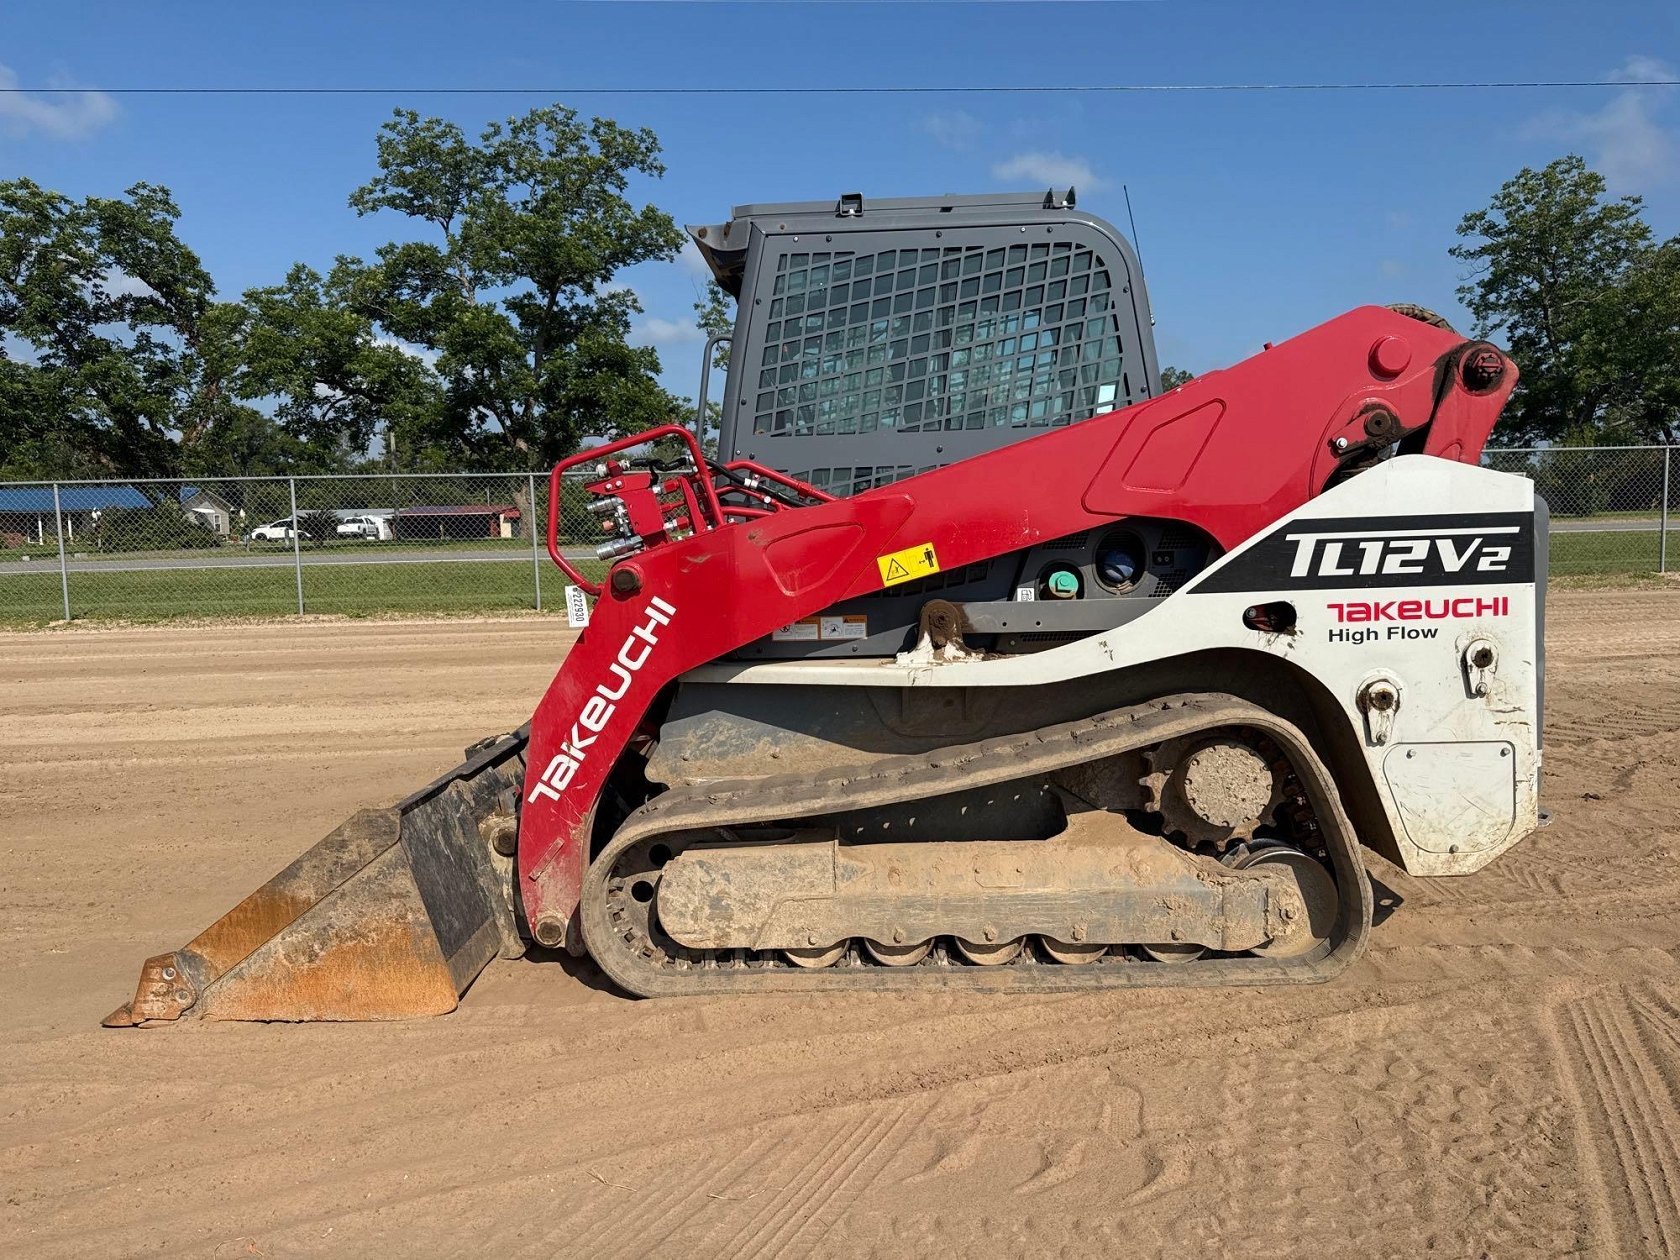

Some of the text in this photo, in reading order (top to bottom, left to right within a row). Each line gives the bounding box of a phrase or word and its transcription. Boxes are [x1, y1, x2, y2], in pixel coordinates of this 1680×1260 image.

[1327, 596, 1509, 623] TAKEUCHI
[1328, 626, 1439, 645] High Flow
[527, 595, 677, 804] TAKEUCHI
